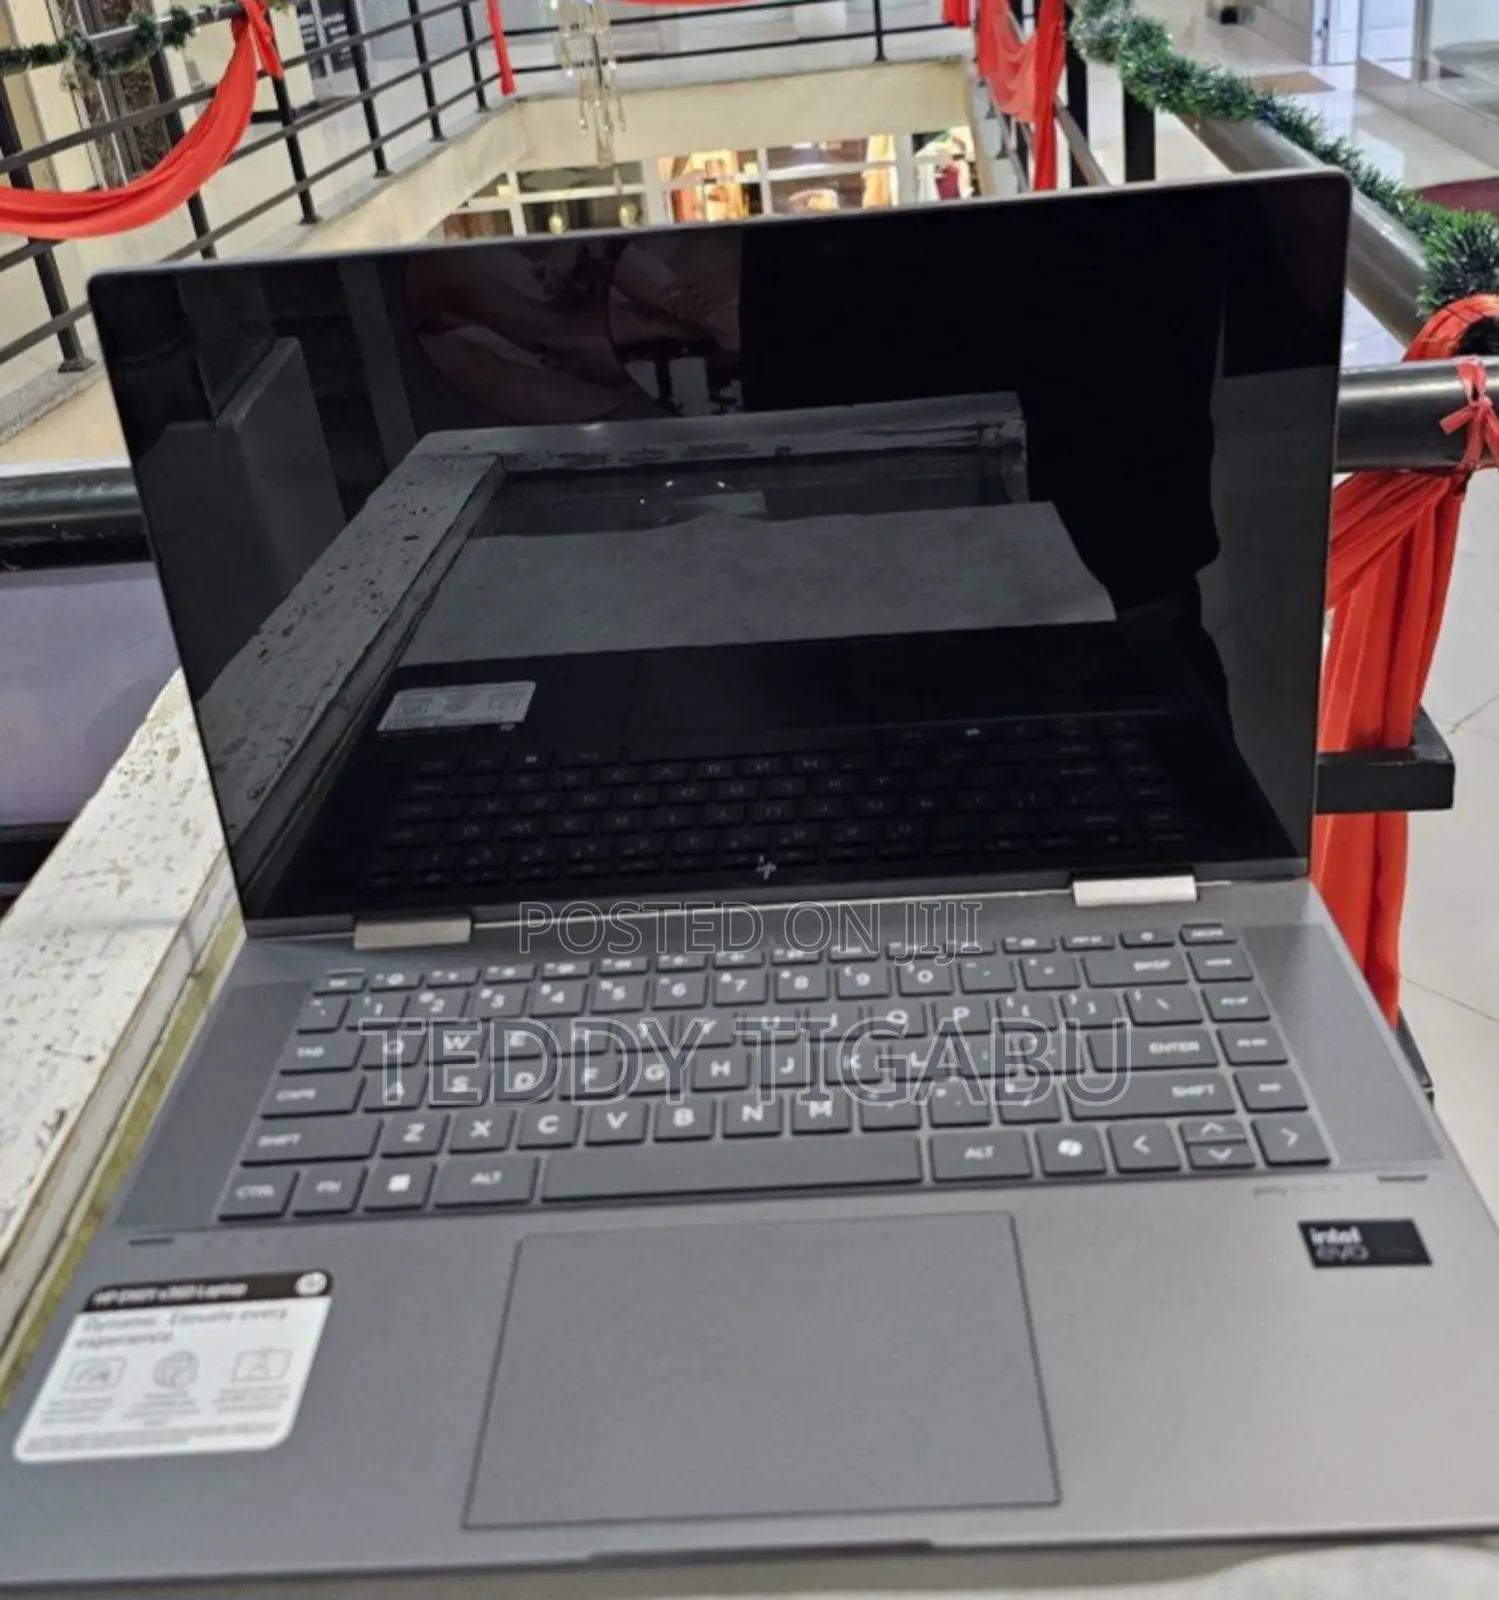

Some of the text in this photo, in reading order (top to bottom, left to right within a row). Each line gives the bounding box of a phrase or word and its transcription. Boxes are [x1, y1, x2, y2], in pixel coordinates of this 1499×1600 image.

[733, 979, 747, 992] 7
[549, 991, 565, 1004] 4
[952, 1006, 971, 1023] P
[443, 1033, 471, 1050] W
[1148, 1040, 1200, 1055] ENTER
[710, 1060, 731, 1077] H
[779, 1057, 795, 1075] J
[842, 1053, 862, 1071] K
[513, 1072, 536, 1091] D
[643, 1063, 666, 1082] G
[451, 1075, 471, 1092] S
[674, 1107, 695, 1127] B
[741, 1104, 764, 1123] N
[808, 1099, 833, 1119] M
[470, 1119, 493, 1138] X
[537, 1115, 560, 1134] C
[605, 1111, 628, 1130] V
[403, 1122, 426, 1143] Z
[964, 1145, 995, 1160] ALT
